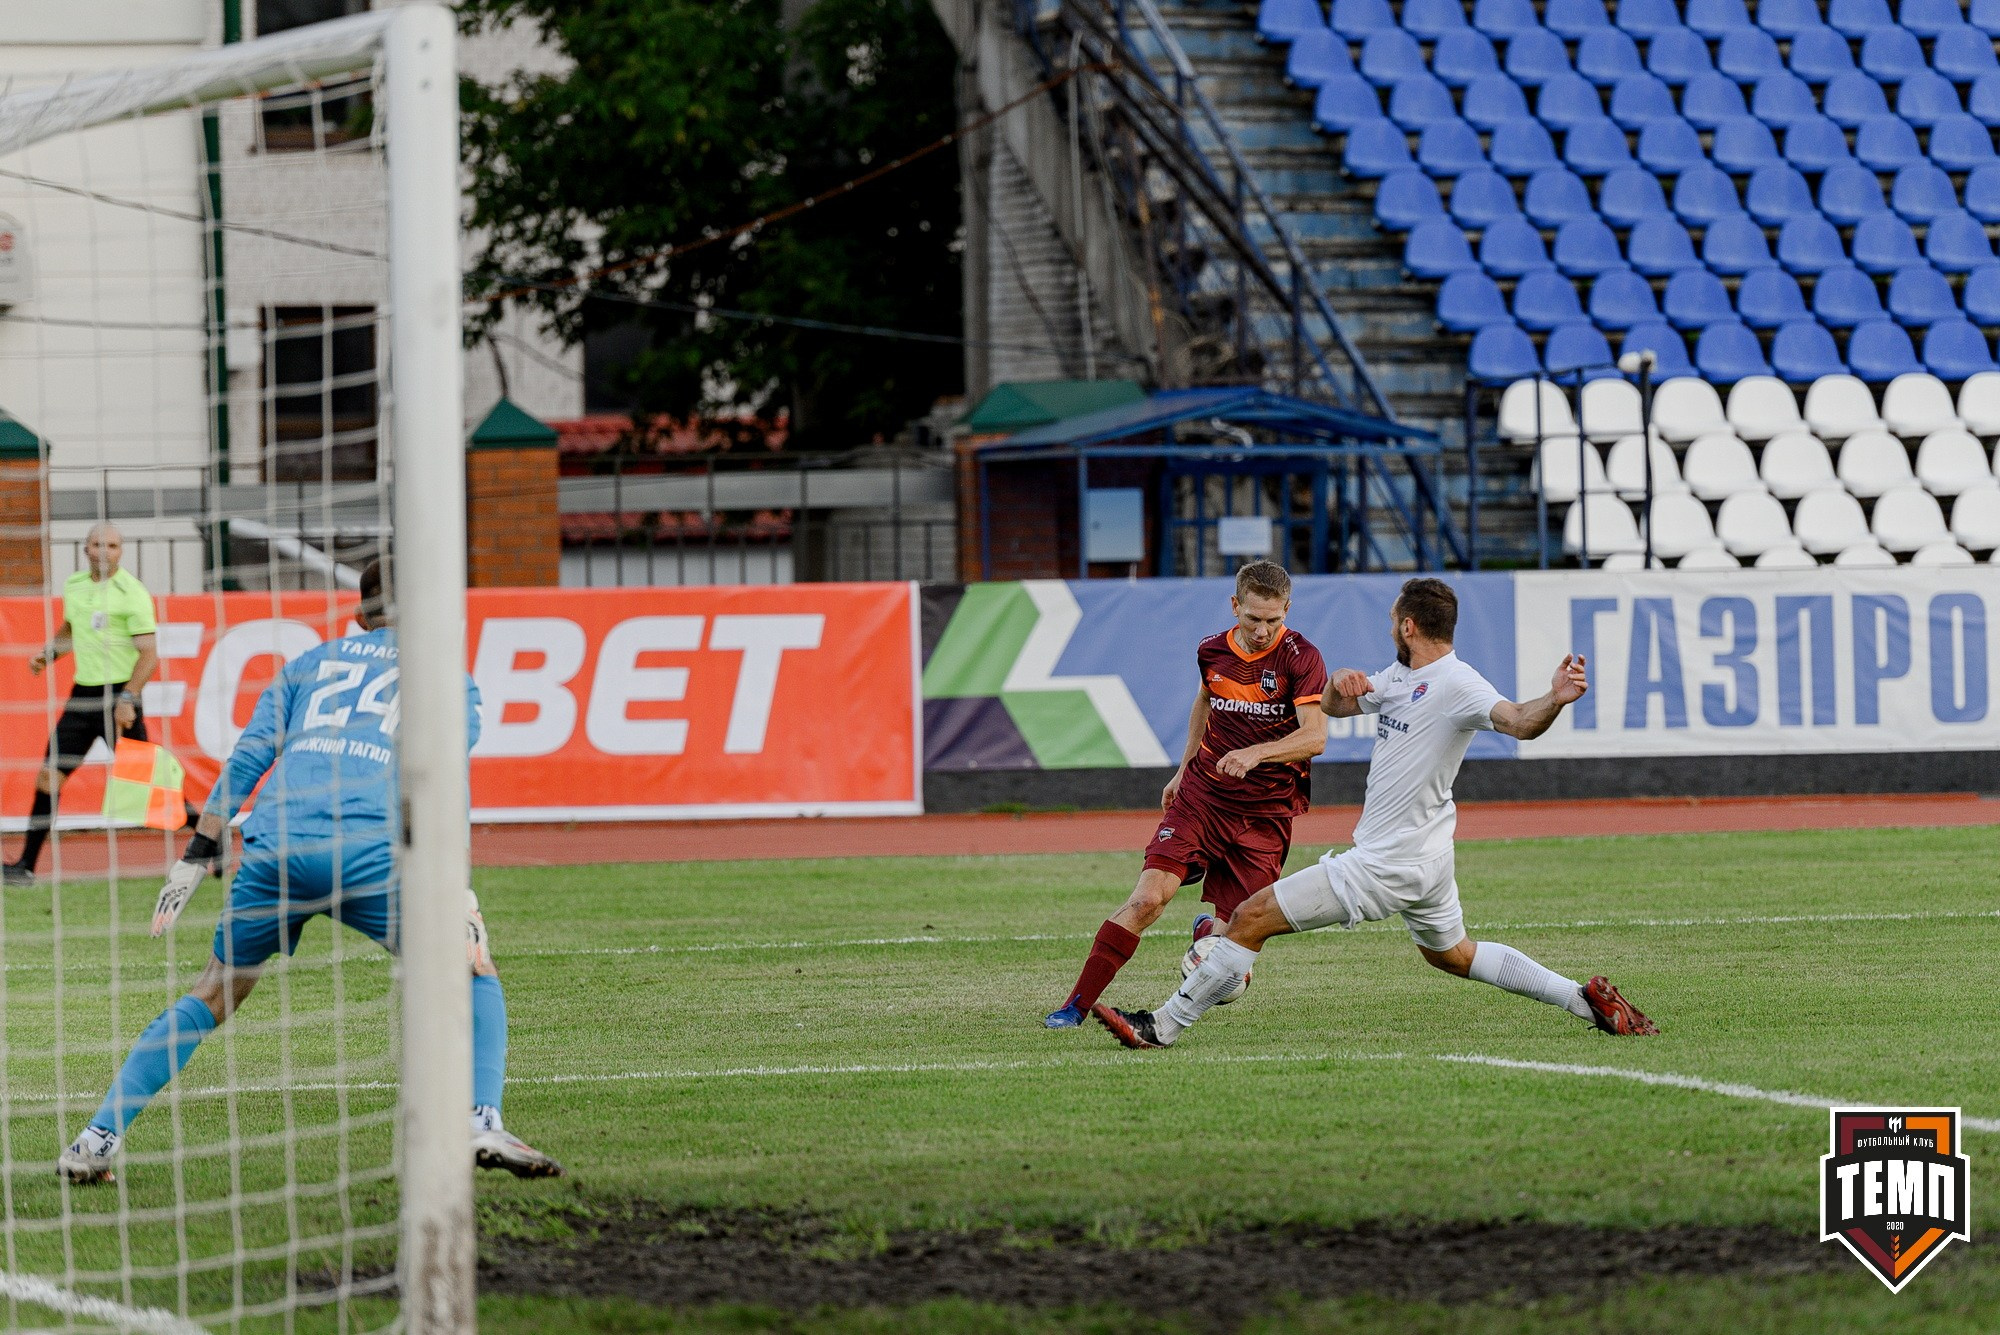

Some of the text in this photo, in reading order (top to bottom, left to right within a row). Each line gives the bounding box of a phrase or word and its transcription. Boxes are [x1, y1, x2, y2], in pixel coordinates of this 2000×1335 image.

[84, 614, 825, 764] FOBET
[303, 660, 400, 735] 24
[1569, 593, 1988, 731] ГАЗПРО
[1210, 697, 1285, 715] РОДИНВЕСТ
[348, 740, 392, 765] ТАГИЛ
